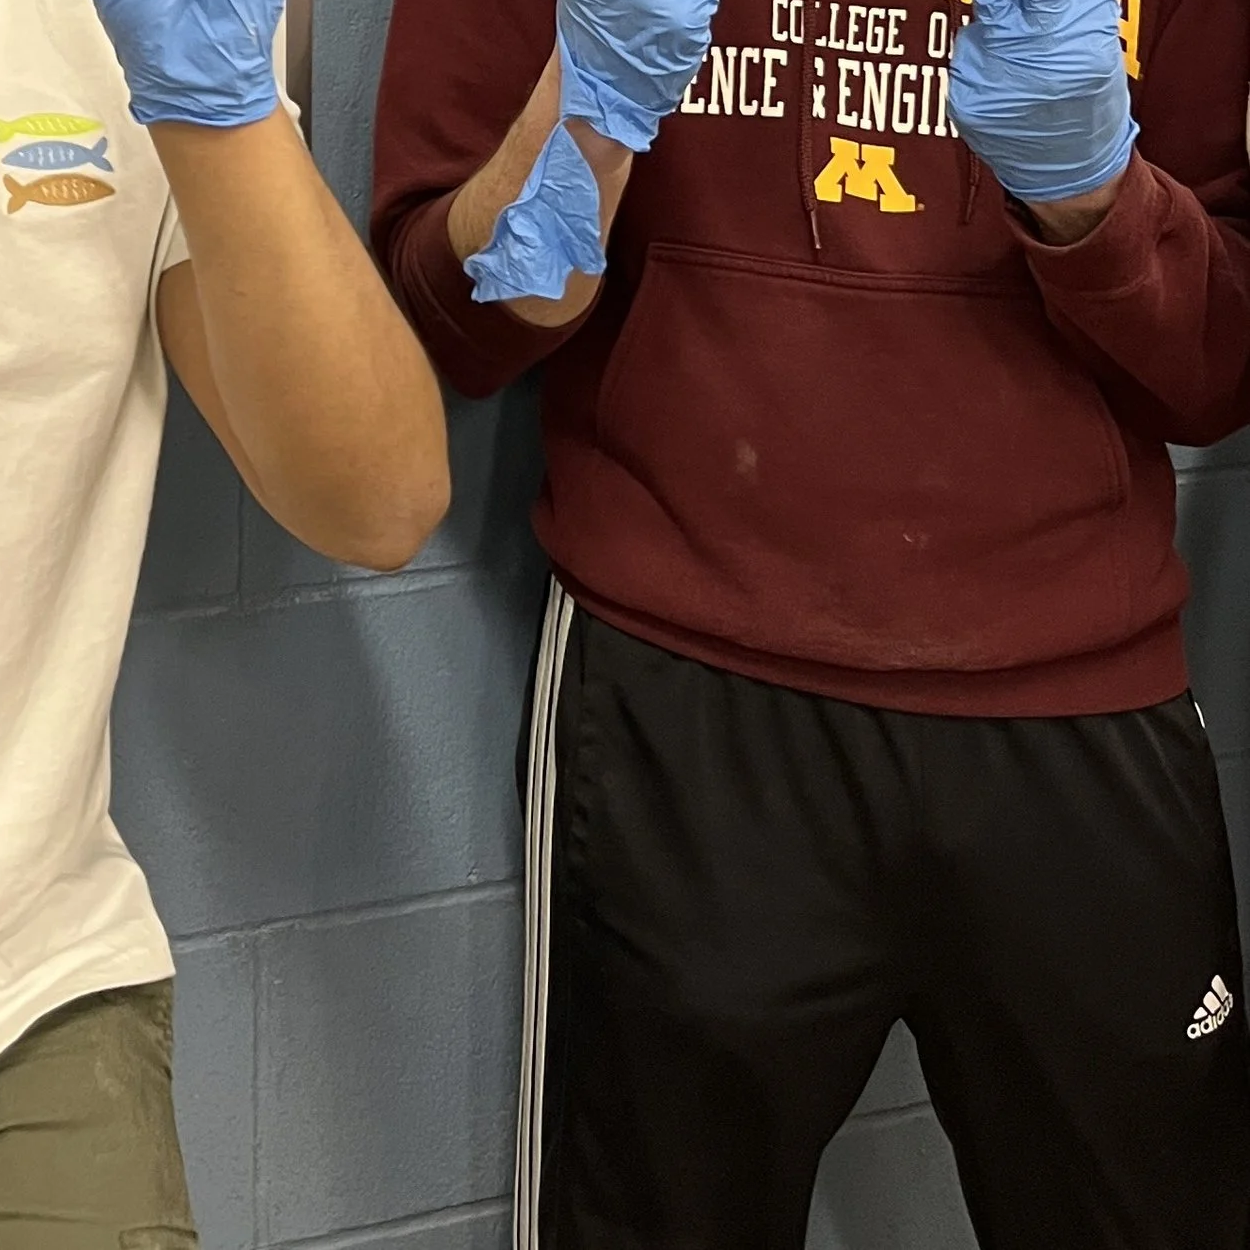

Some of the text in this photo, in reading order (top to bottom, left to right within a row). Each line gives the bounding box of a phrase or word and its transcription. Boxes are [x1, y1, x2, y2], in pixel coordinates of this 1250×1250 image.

[928, 11, 969, 59] O
[671, 46, 788, 118] ENCE
[837, 58, 958, 138] ENGIN
[814, 136, 916, 214] M
